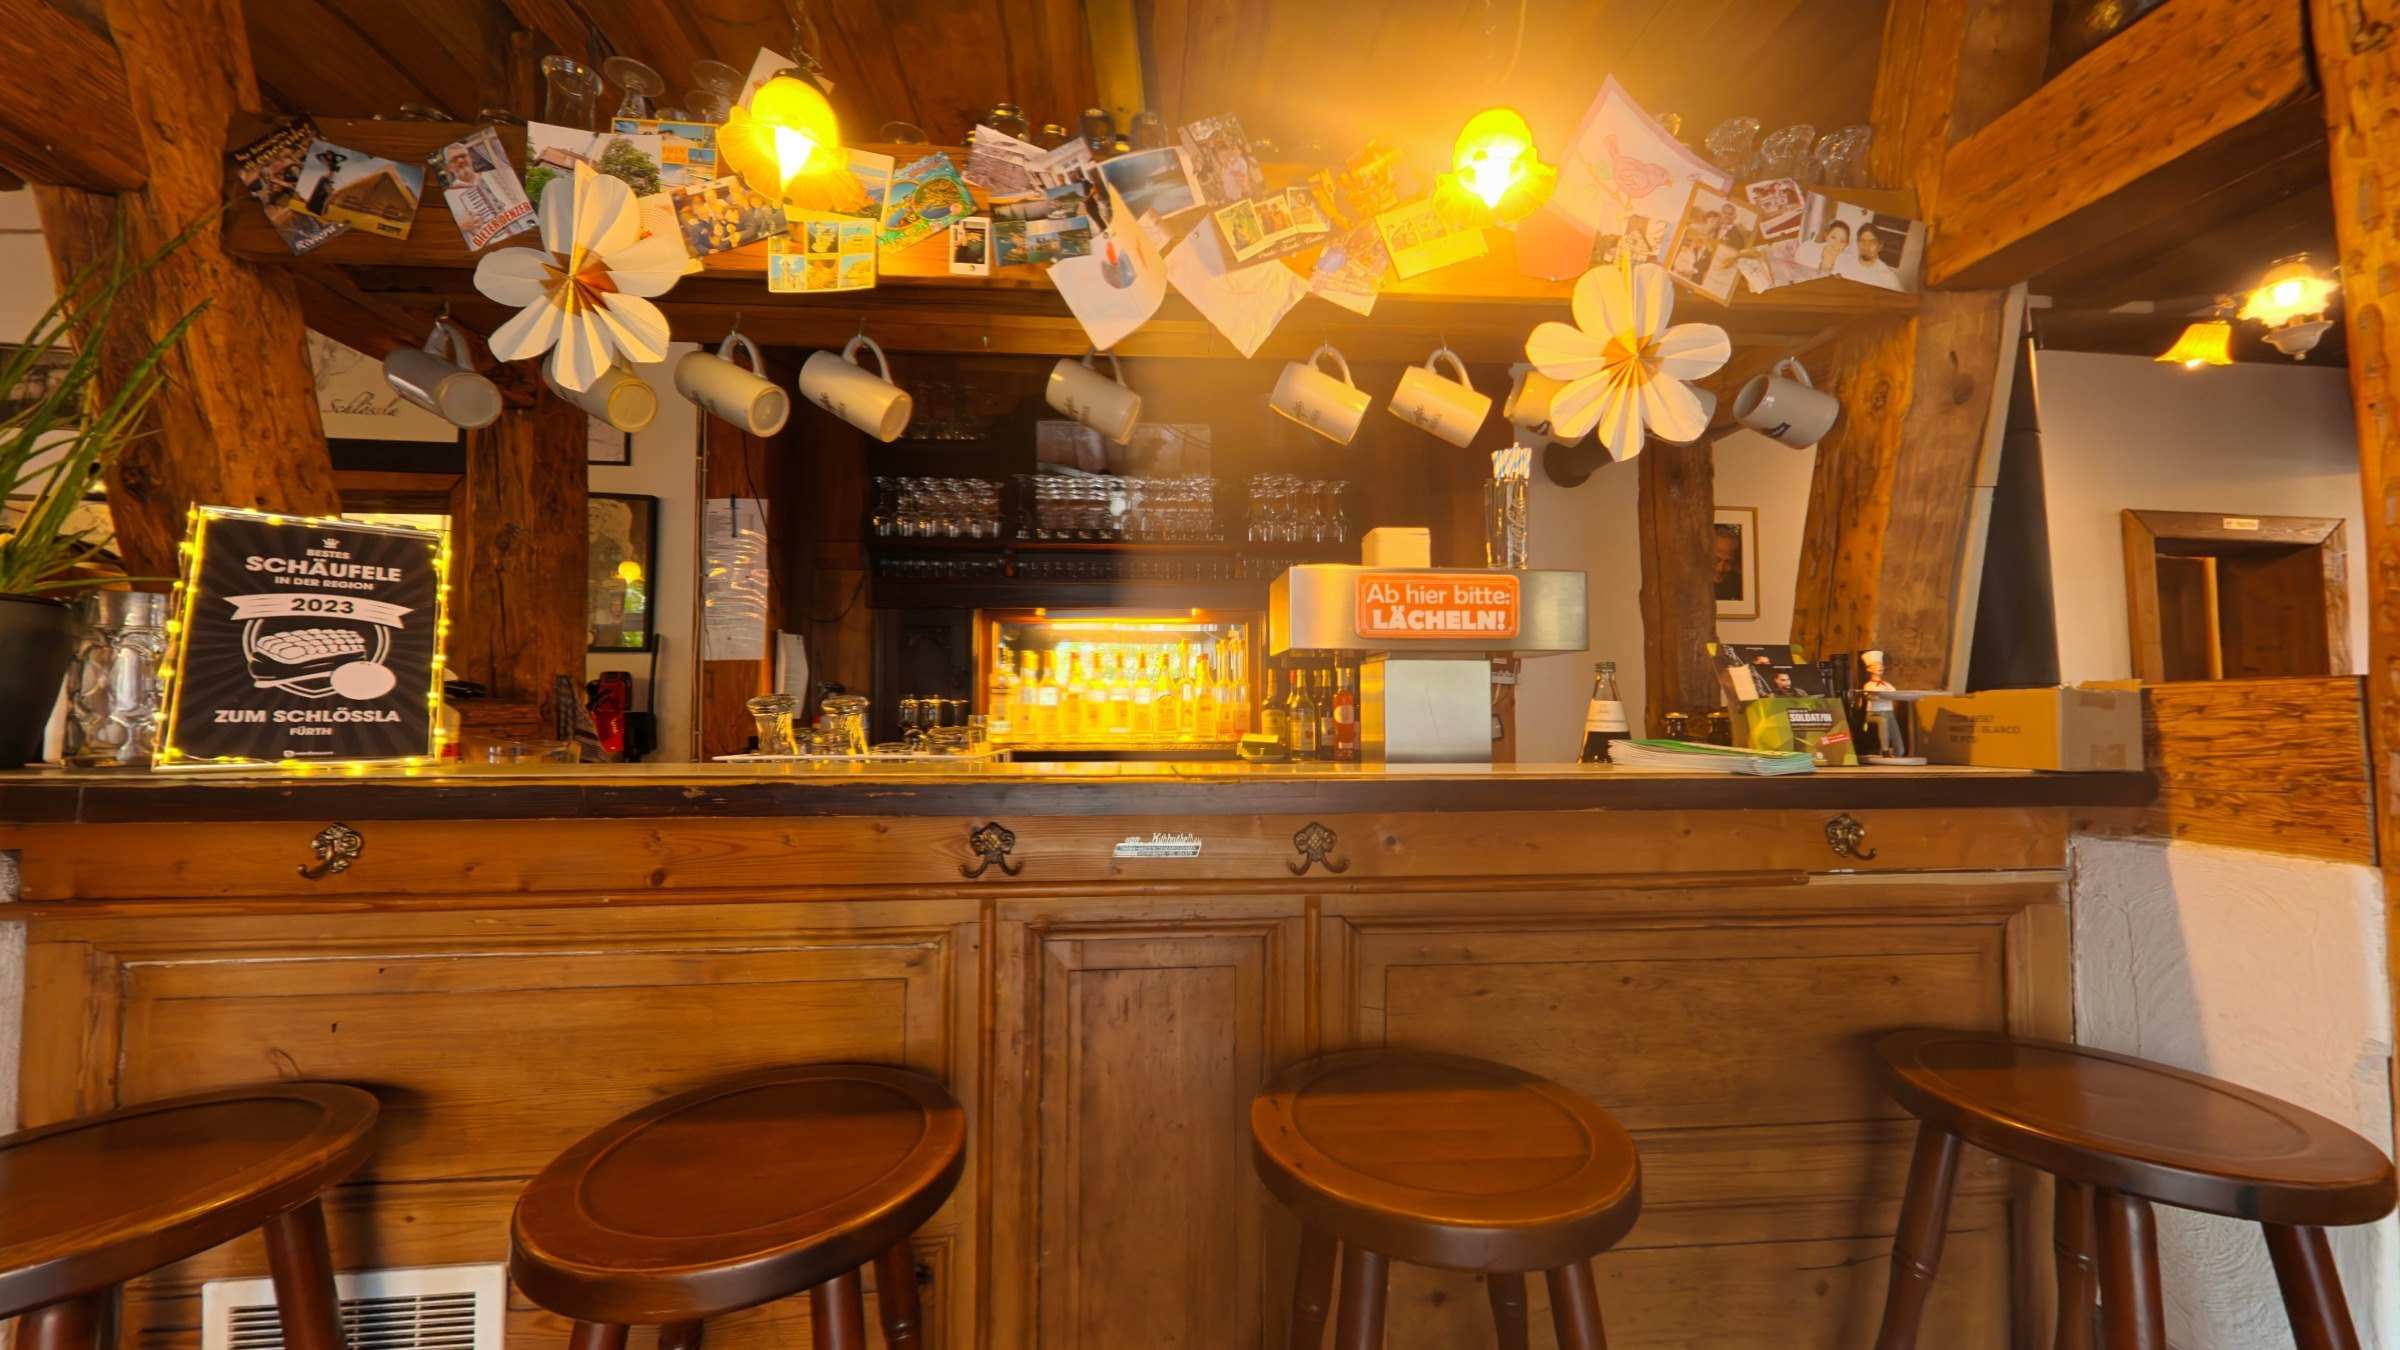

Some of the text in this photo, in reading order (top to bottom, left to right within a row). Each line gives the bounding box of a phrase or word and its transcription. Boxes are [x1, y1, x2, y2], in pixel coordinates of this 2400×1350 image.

[306, 549, 351, 559] BESTES
[245, 556, 402, 582] SCHÄUFELE
[275, 576, 375, 590] IN DER REGION
[1367, 583, 1511, 605] Ab hier bitte:
[291, 598, 354, 614] 2023
[1372, 605, 1506, 630] LÄCHELN!
[214, 707, 401, 723] ZUM SCHLÖSSLA
[290, 726, 332, 736] FÜRTH
